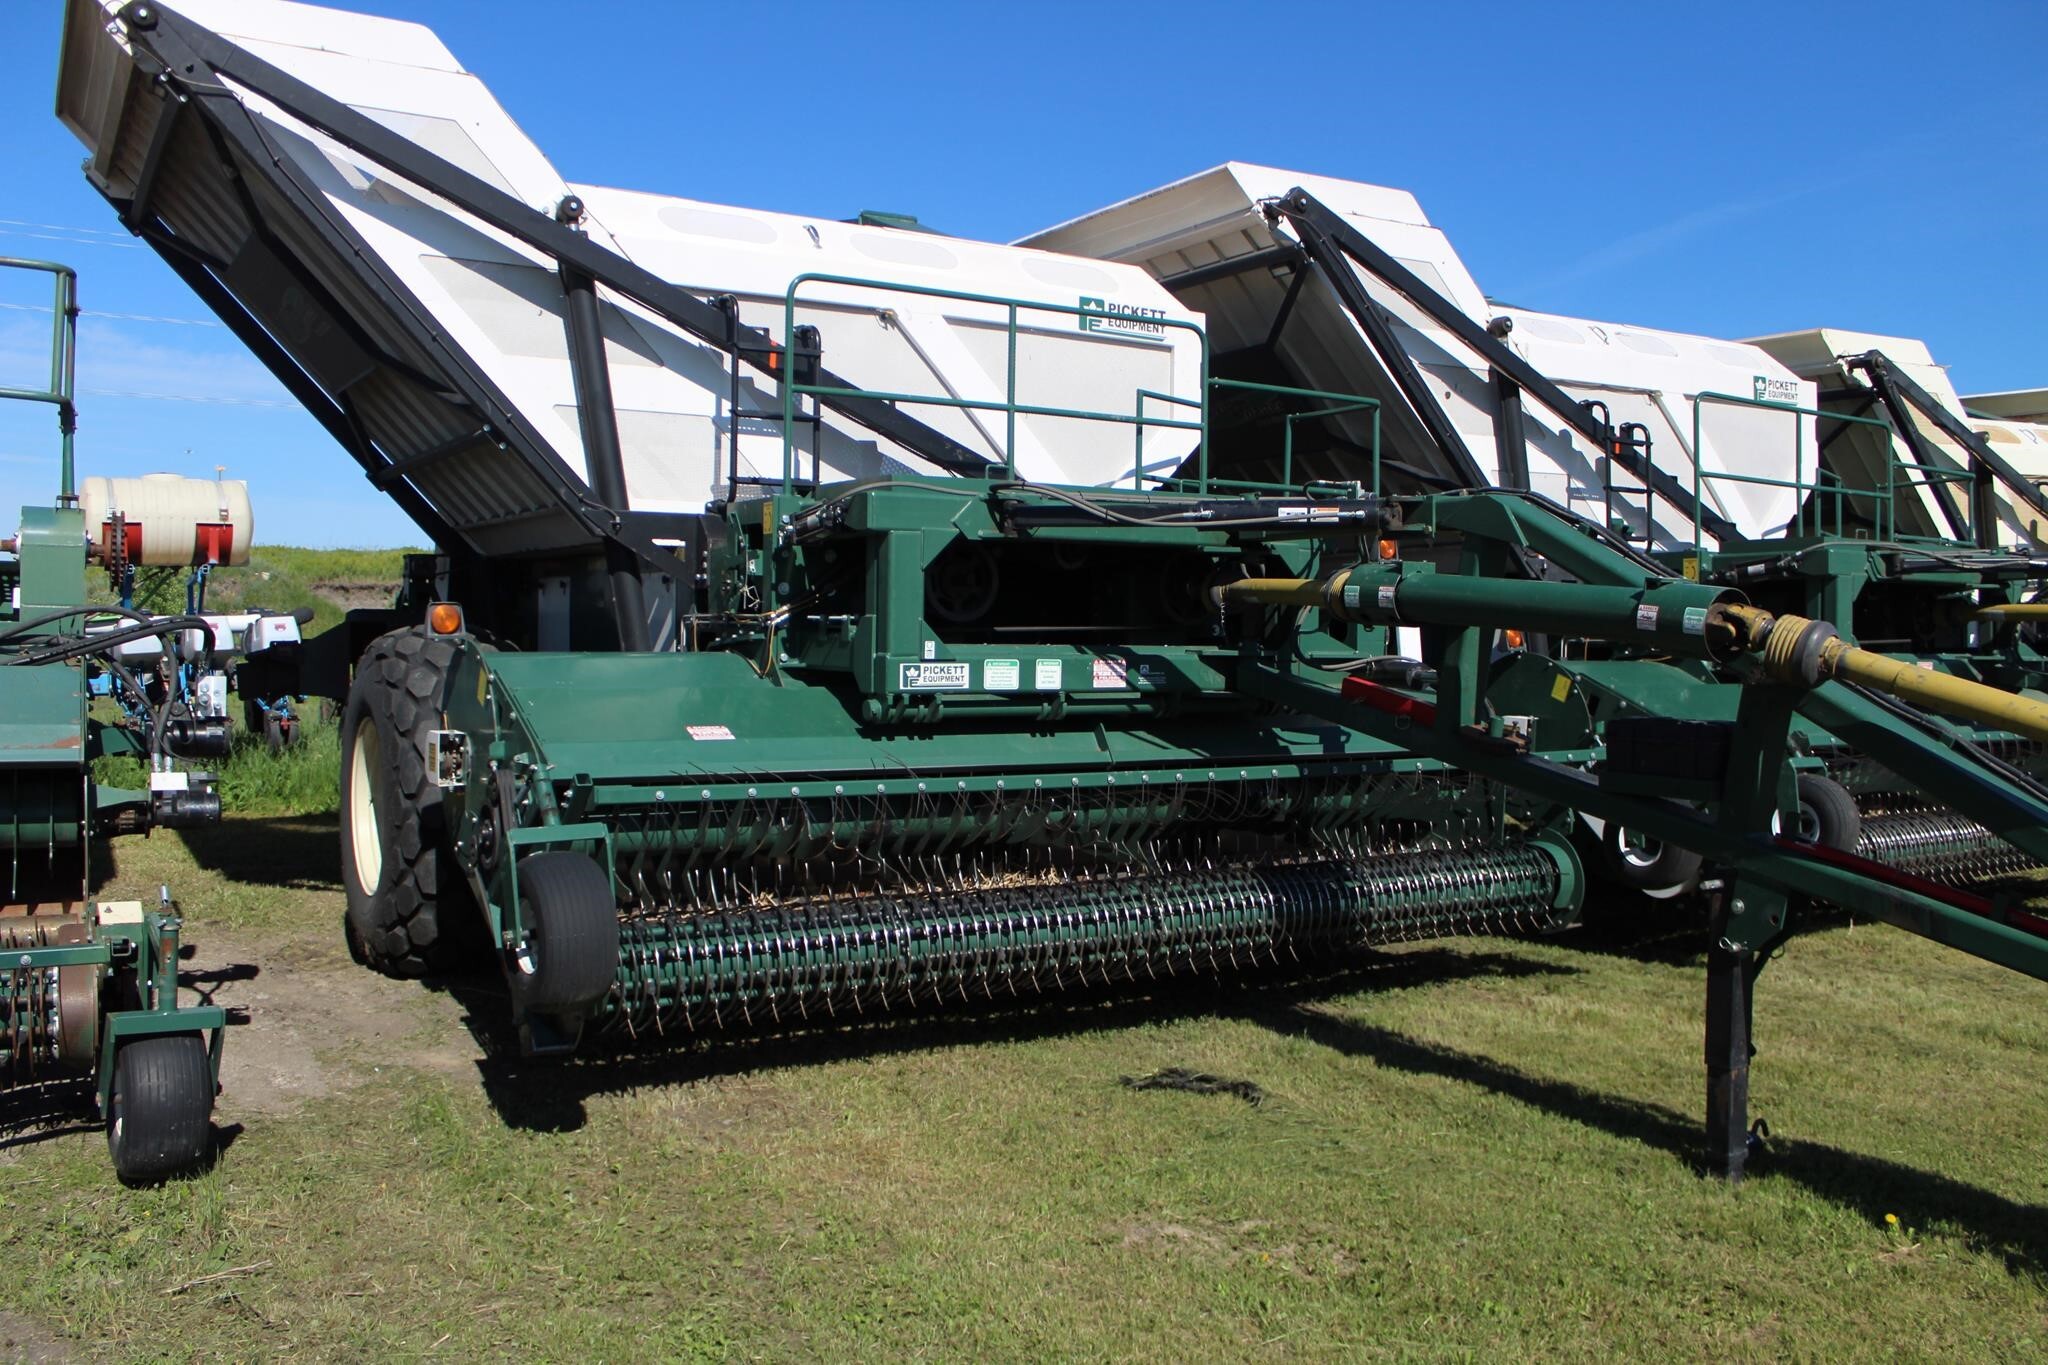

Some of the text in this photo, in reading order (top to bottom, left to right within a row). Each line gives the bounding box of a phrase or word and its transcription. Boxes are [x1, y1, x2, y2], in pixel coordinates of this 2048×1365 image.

[1108, 303, 1166, 320] PICKETT
[1108, 318, 1166, 334] EQUIPMENT
[1768, 380, 1798, 392] PICKETT
[923, 666, 965, 675] PICKETT
